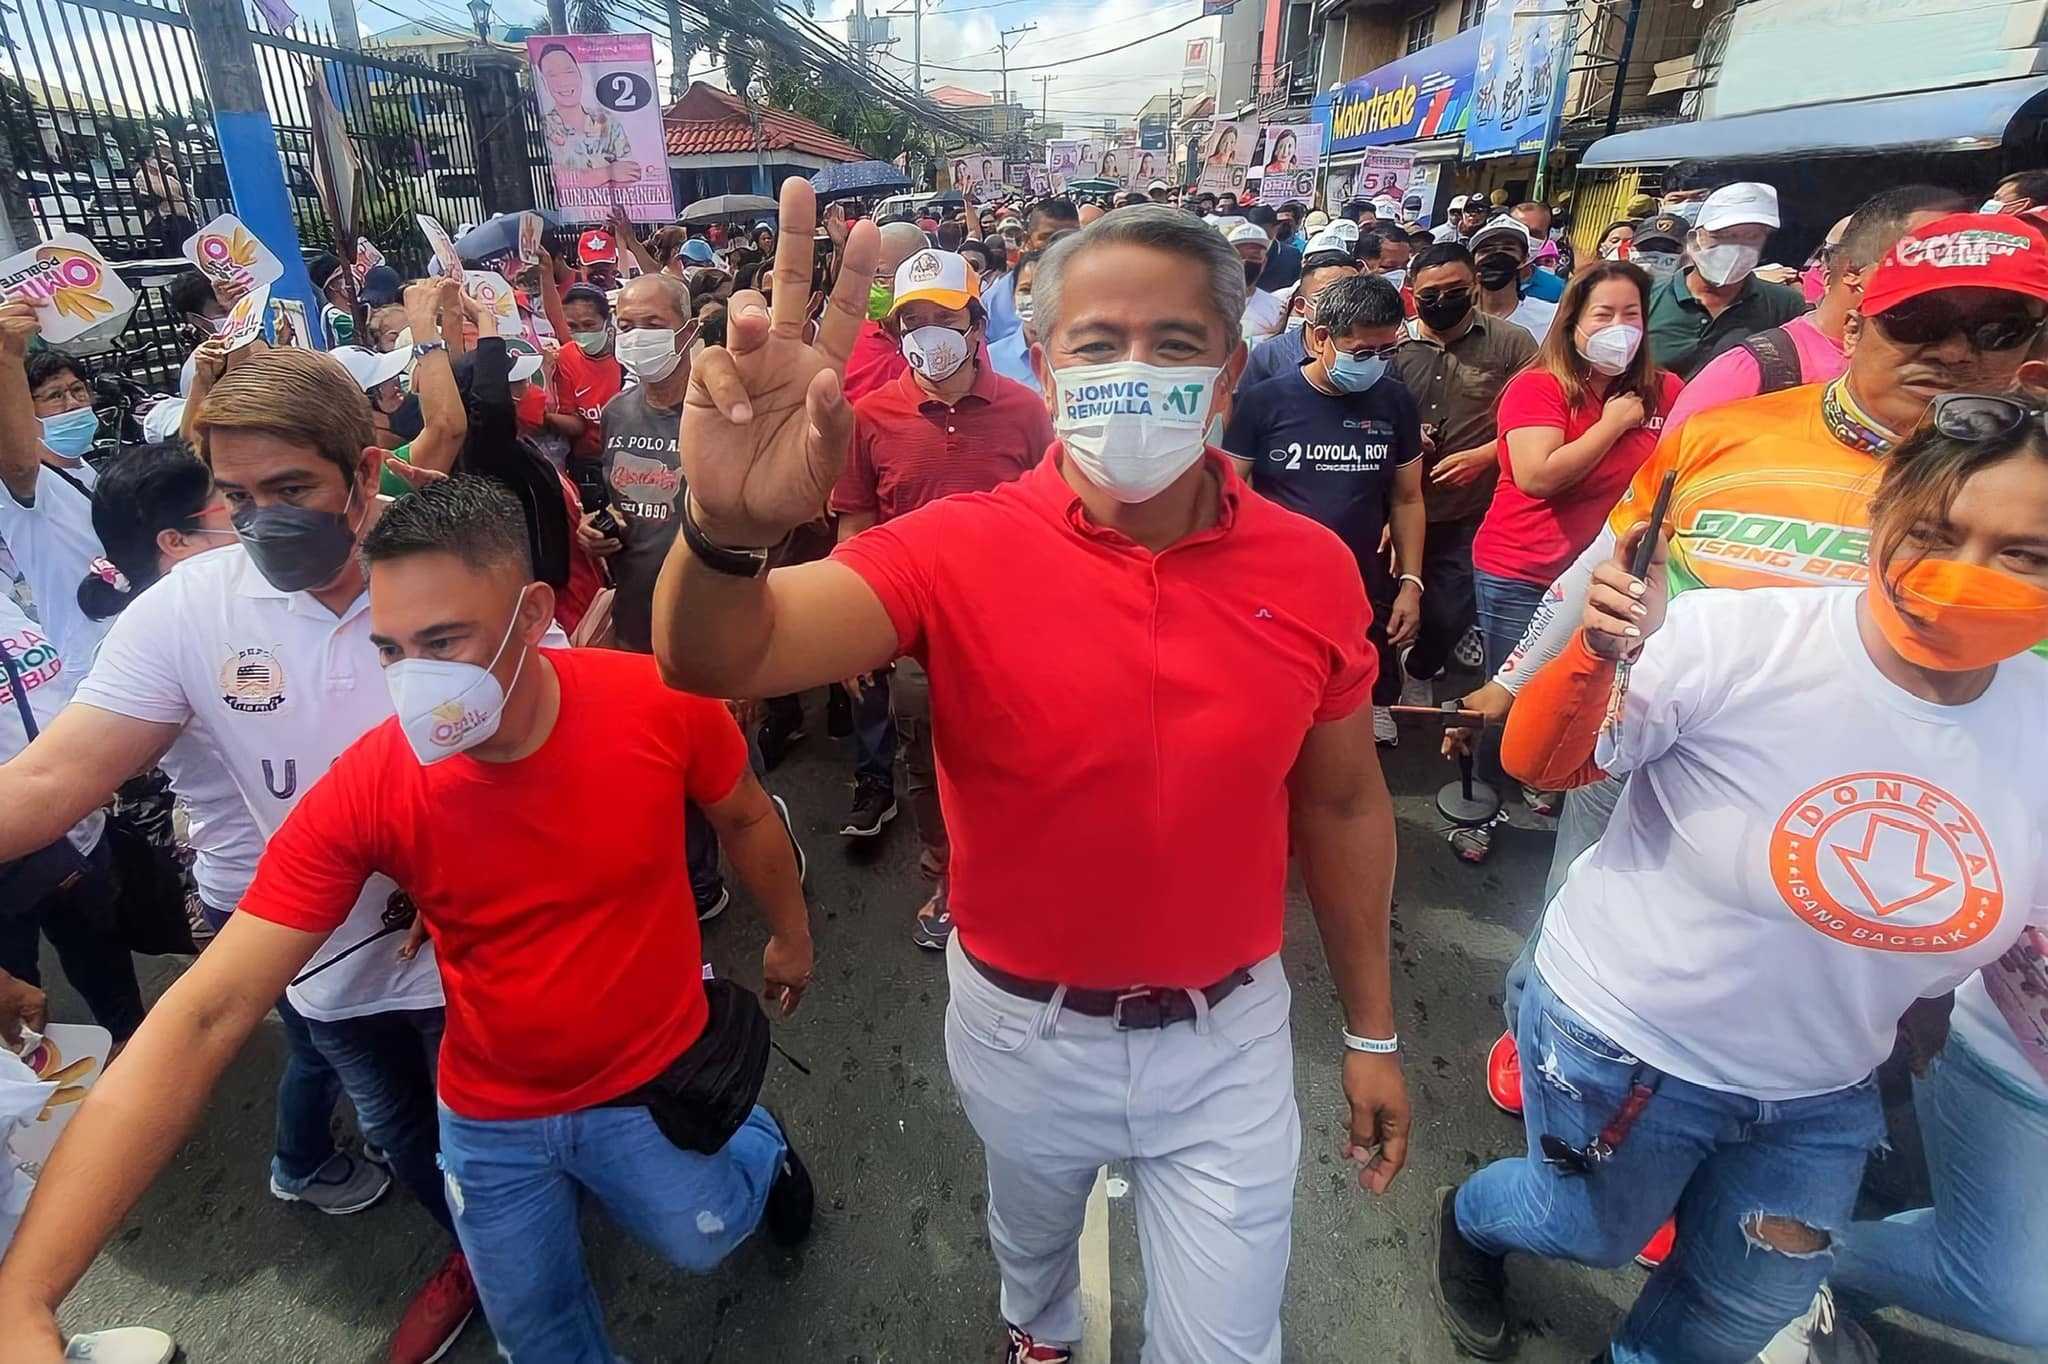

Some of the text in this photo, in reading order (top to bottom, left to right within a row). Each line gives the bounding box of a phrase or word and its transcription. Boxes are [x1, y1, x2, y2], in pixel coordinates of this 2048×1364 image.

[612, 76, 636, 106] 2
[1333, 76, 1416, 139] Motortrade
[1296, 172, 1314, 194] 6
[1363, 173, 1379, 189] 5
[1075, 382, 1149, 402] JONVIC
[1067, 399, 1152, 420] REMULLA
[628, 436, 664, 451] POLO
[1285, 442, 1388, 470] 2 LOYOLA, ROY
[1696, 513, 1869, 564] DONE
[1797, 780, 1989, 876] DONEZA
[1788, 879, 1968, 947] ISANG BAGSAK
